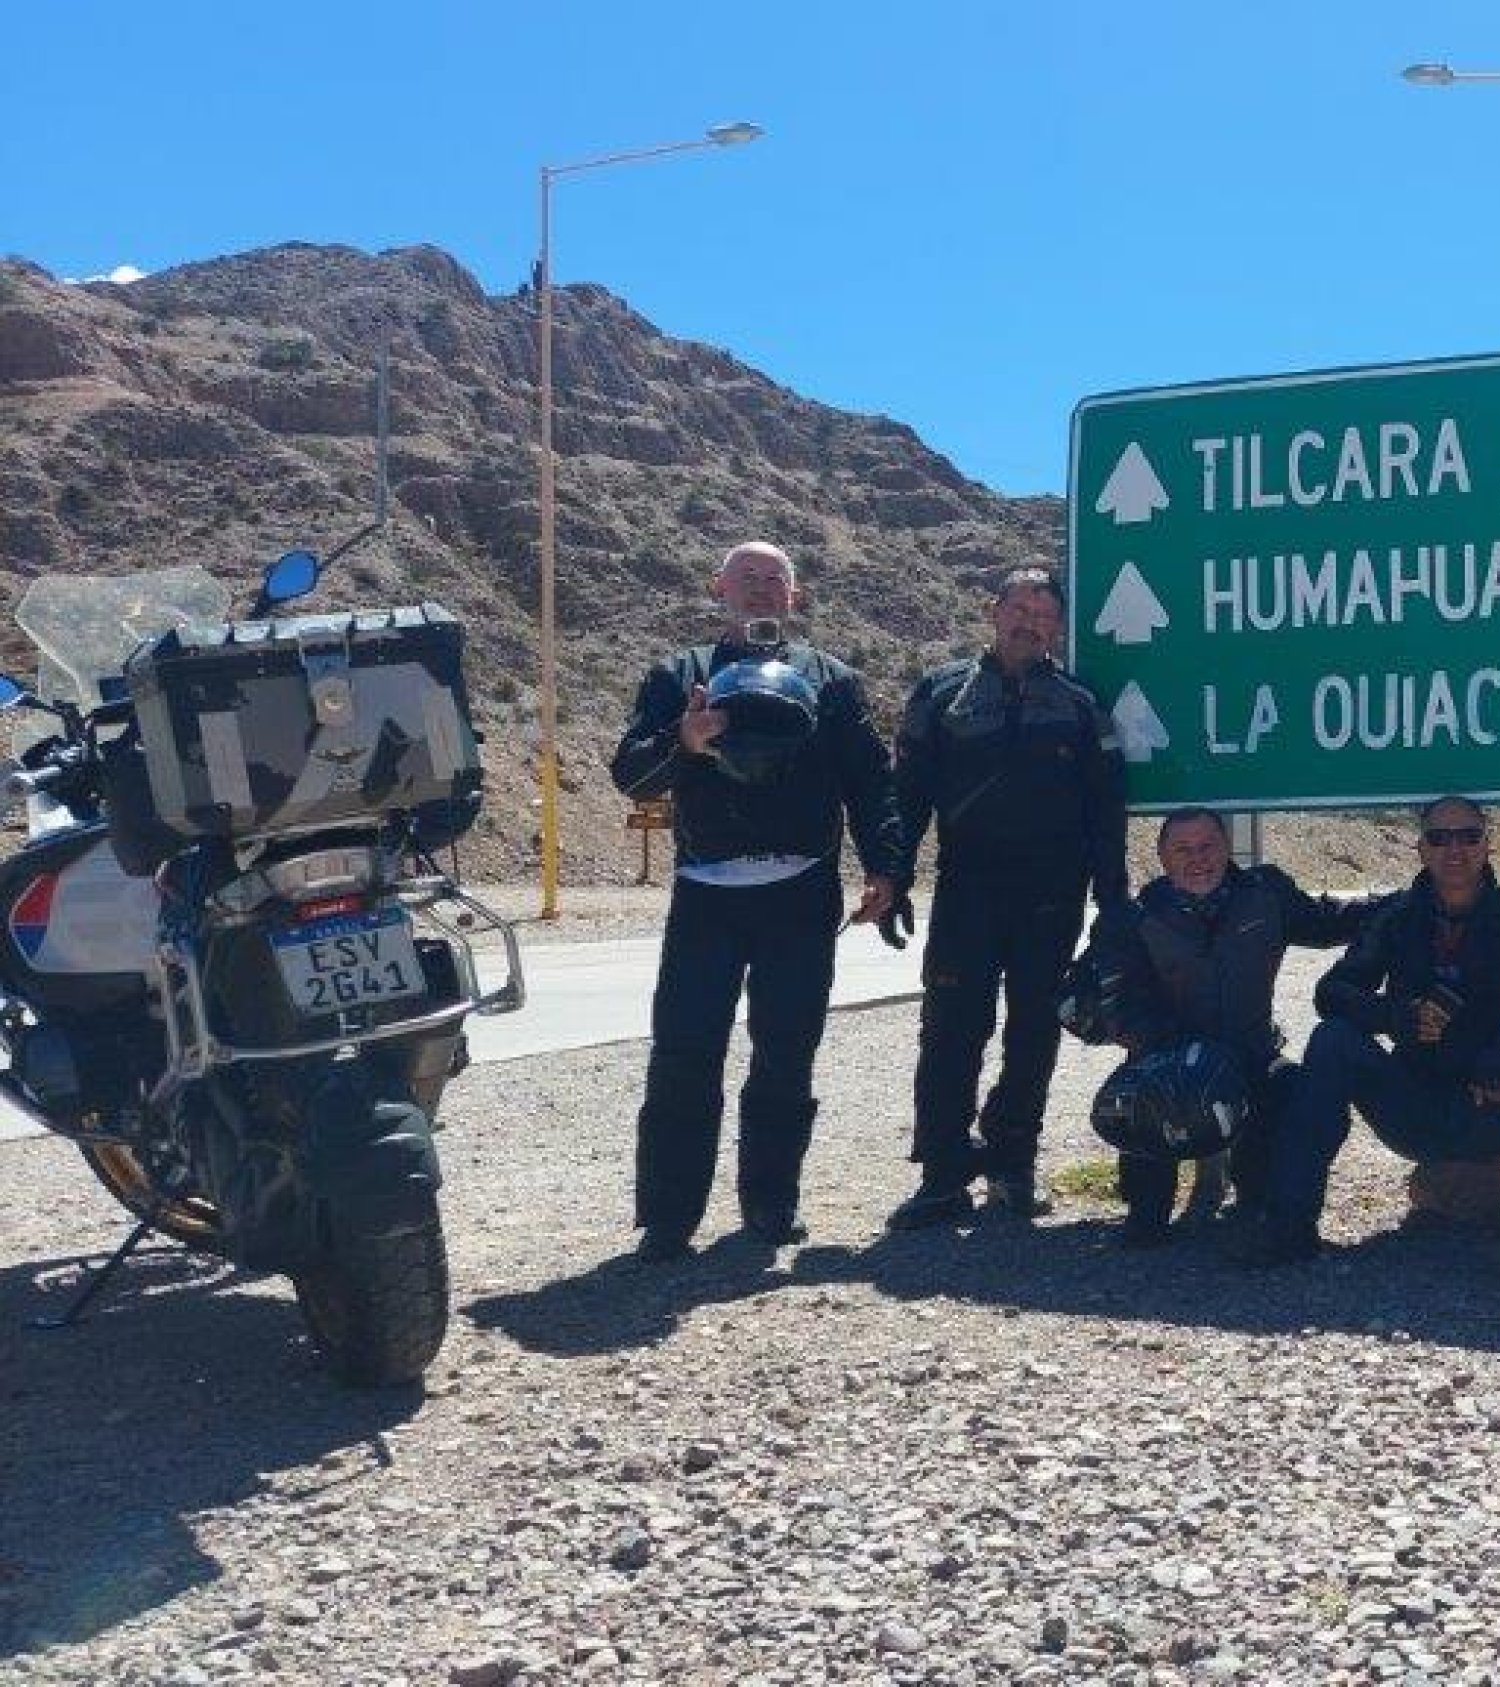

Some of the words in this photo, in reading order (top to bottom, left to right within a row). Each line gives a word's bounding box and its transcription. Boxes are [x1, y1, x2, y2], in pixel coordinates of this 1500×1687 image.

[1192, 418, 1472, 511] TILCARA
[1203, 684, 1279, 754] LA
[305, 961, 408, 1008] 2G41
